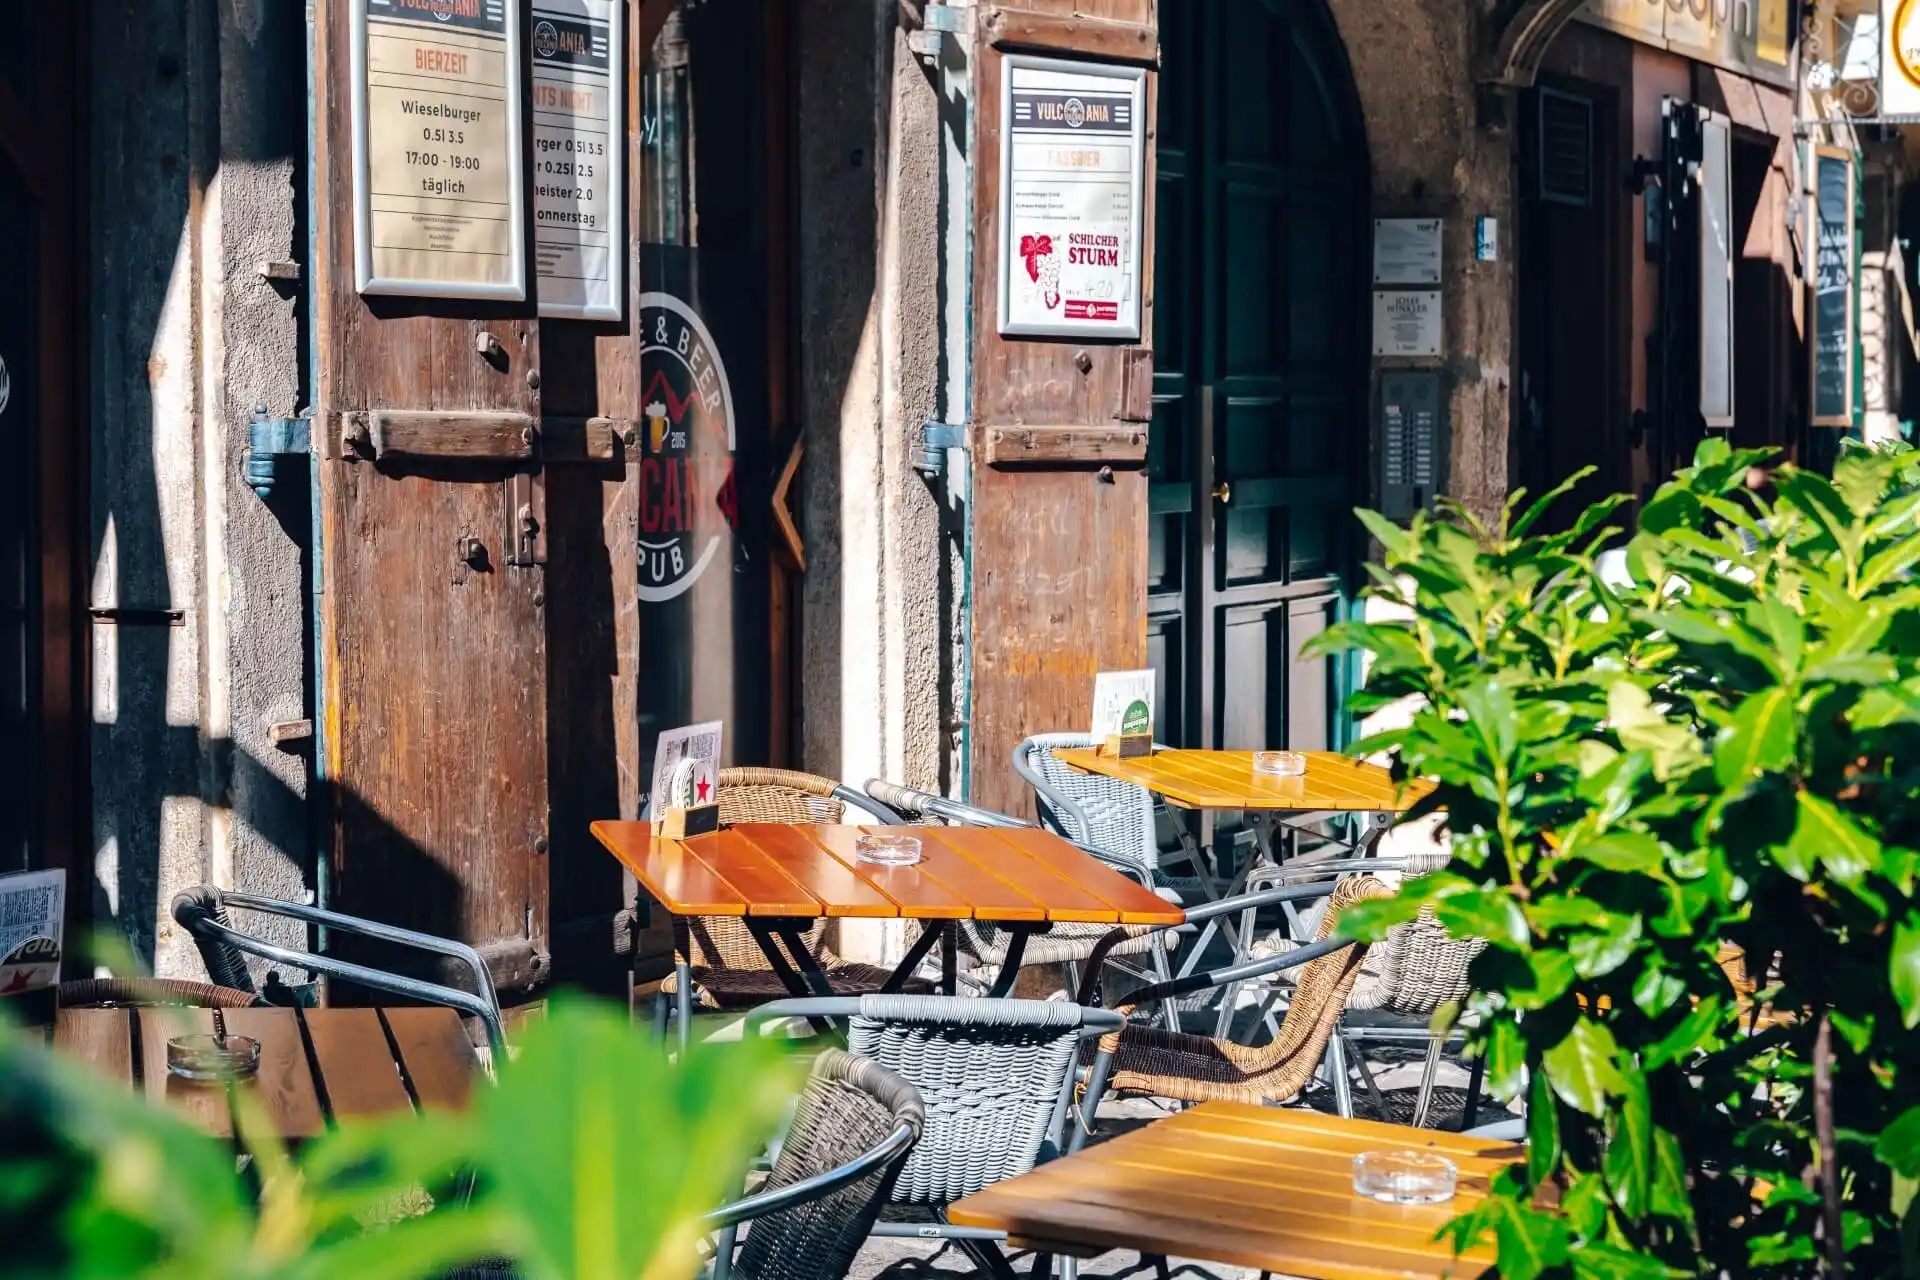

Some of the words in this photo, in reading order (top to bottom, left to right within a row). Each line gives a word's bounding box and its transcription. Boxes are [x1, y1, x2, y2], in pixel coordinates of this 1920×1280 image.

[415, 48, 468, 74] BIERZEIT
[401, 99, 481, 123] Wieselburger
[448, 130, 464, 144] 3.5
[588, 142, 603, 156] 3.5
[406, 151, 439, 166] 17:00
[449, 154, 480, 170] 19:00
[578, 165, 593, 178] 2.5
[422, 177, 465, 195] täglich
[575, 188, 593, 201] 2.0
[537, 209, 595, 226] onnerstag
[1068, 232, 1119, 248] SCHILCHER
[1068, 246, 1118, 267] STURM
[655, 315, 669, 344] &
[677, 326, 721, 415] BEER
[671, 431, 686, 449] 2015
[640, 457, 739, 533] CANA
